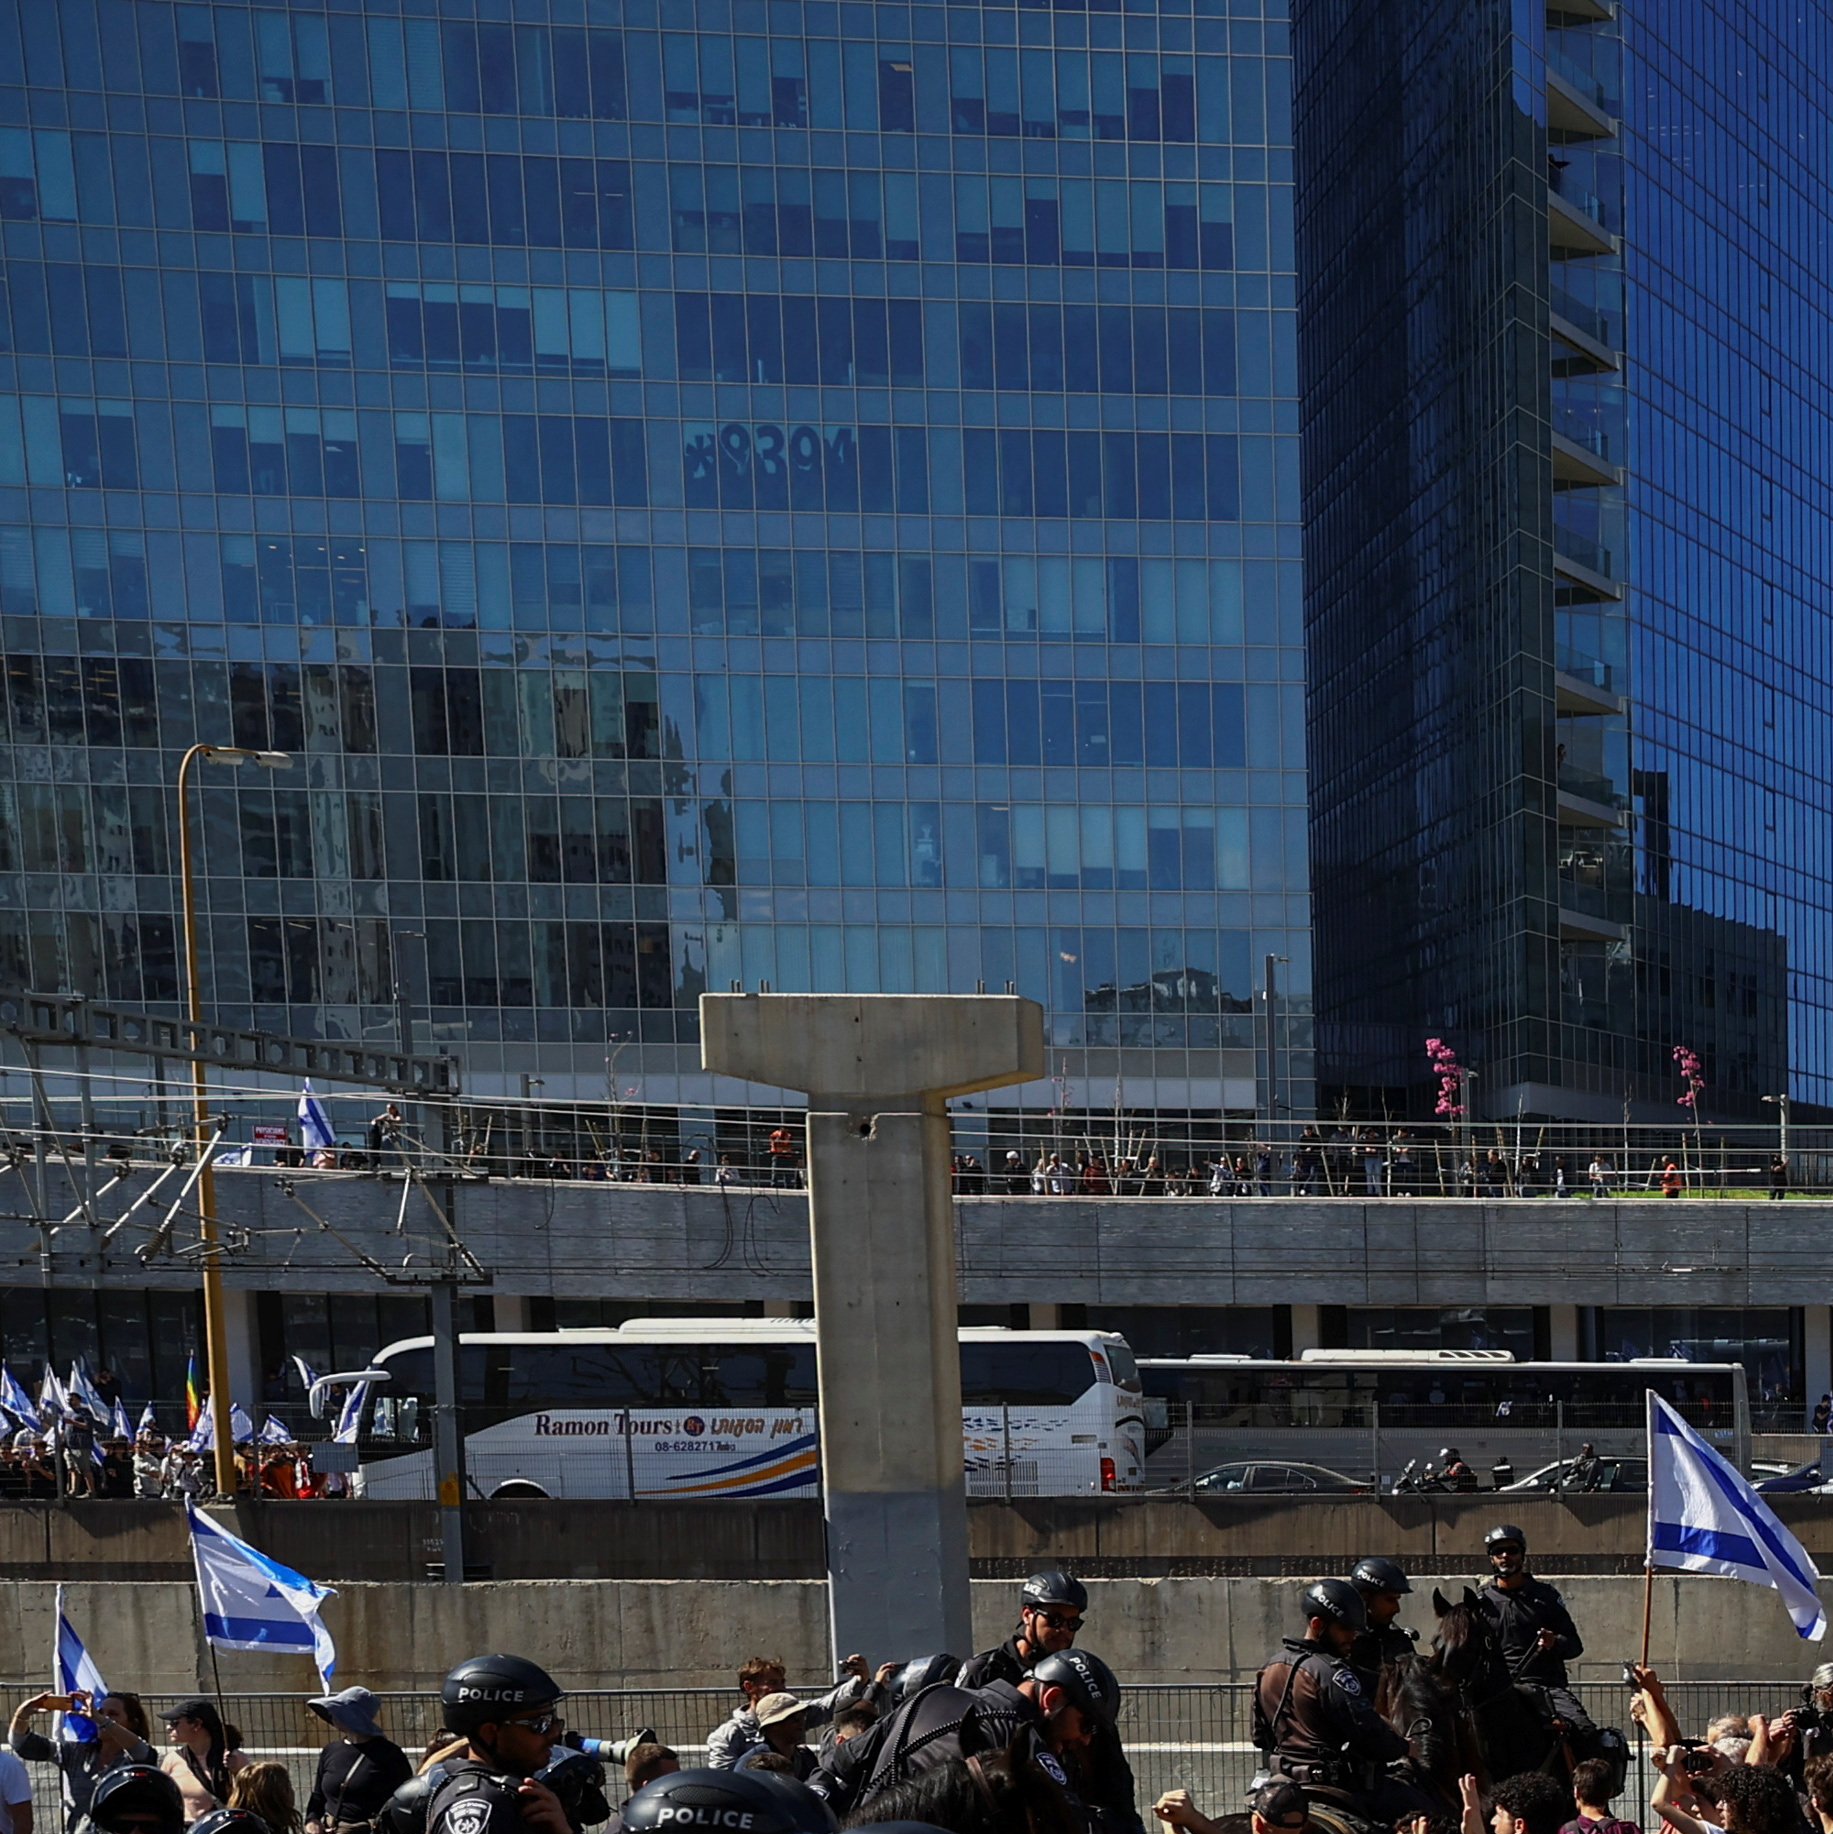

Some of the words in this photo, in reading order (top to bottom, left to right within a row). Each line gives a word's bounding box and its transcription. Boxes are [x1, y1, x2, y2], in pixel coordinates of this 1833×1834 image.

[535, 1415, 609, 1436] Ramon
[614, 1414, 672, 1435] Tours
[1357, 1569, 1385, 1588] POLICE
[1069, 1656, 1102, 1700] POLICE
[458, 1686, 524, 1703] POLICE
[657, 1806, 754, 1831] POLICE
